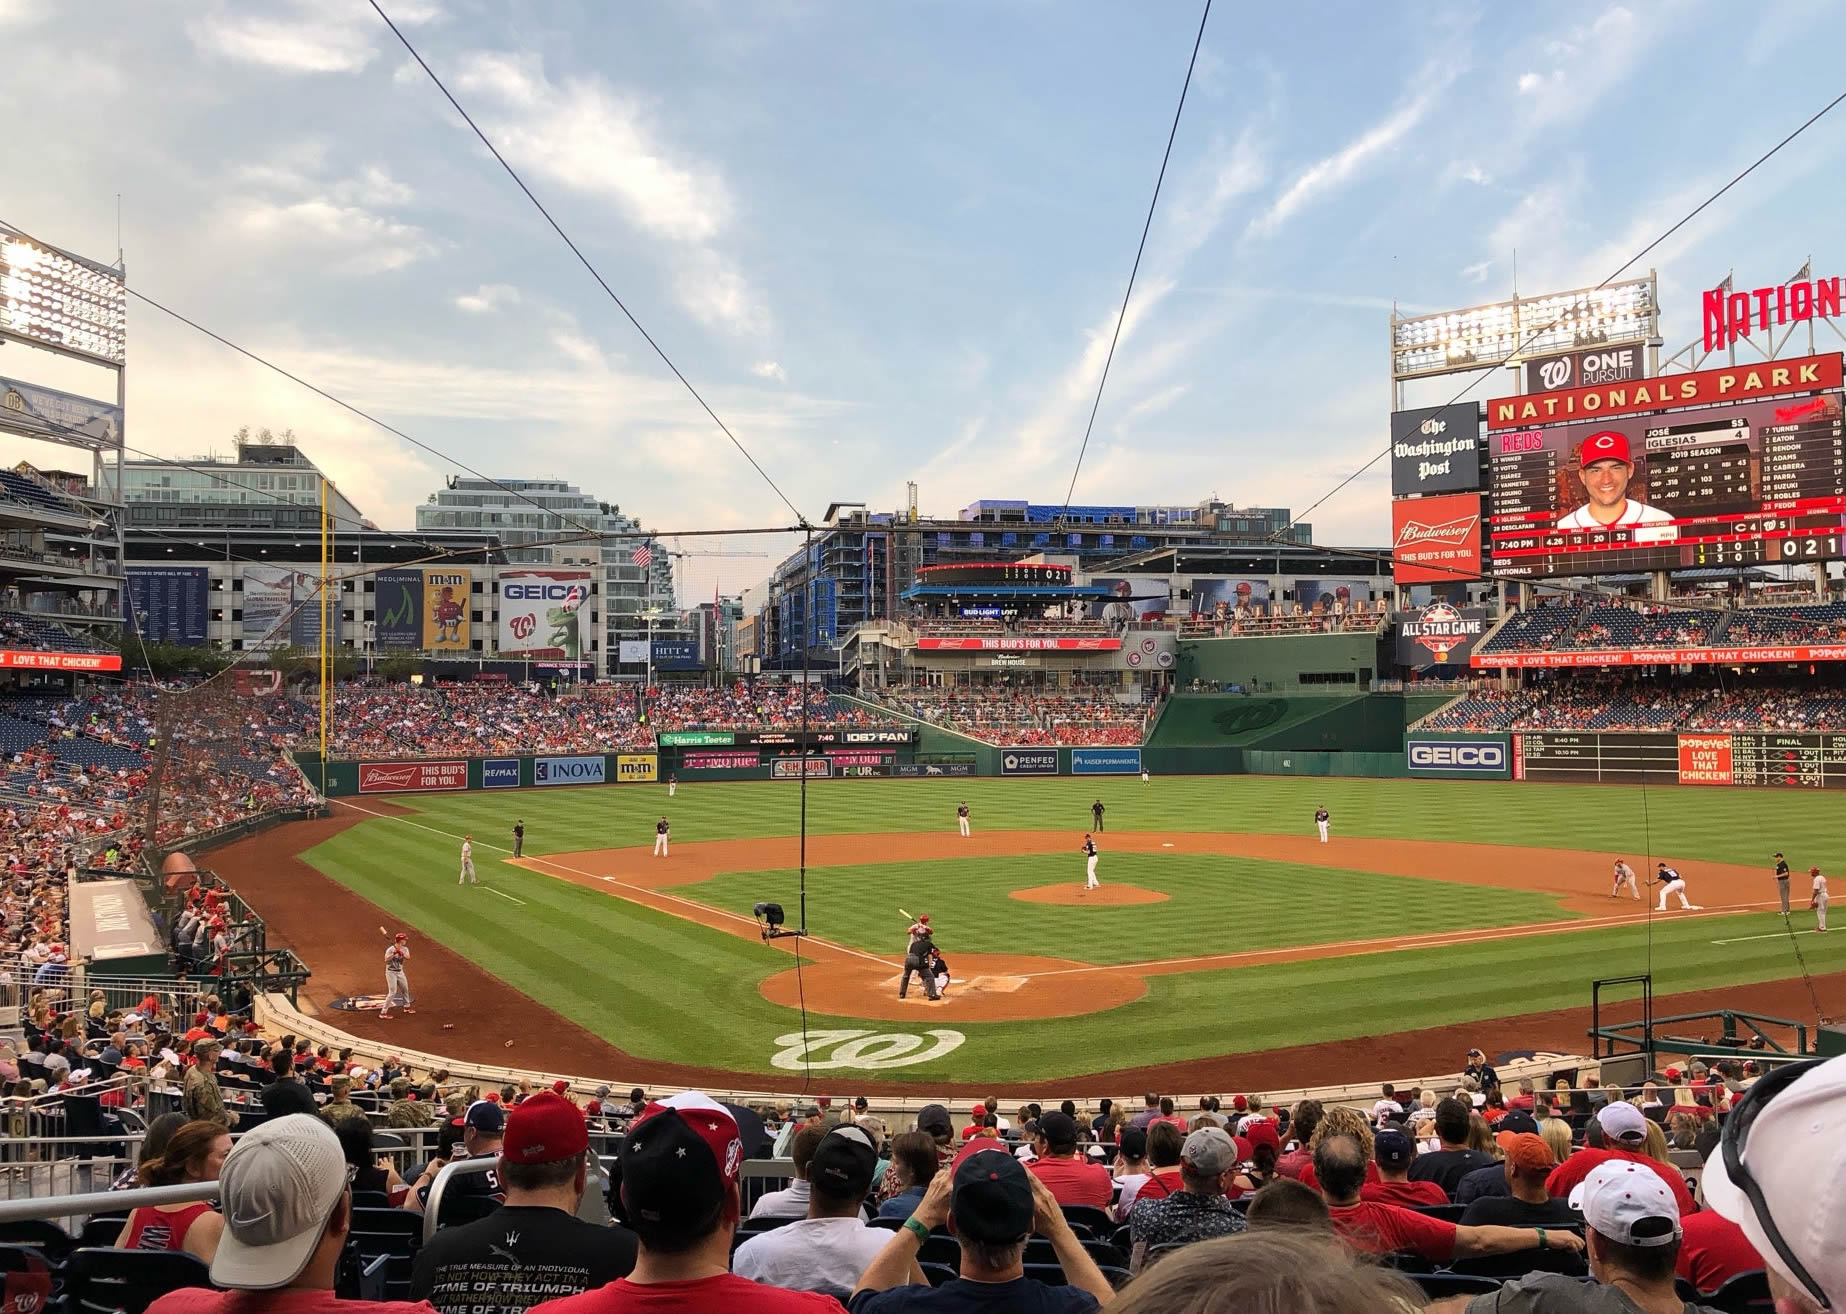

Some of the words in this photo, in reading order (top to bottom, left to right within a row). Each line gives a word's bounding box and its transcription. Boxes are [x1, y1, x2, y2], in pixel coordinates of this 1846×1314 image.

[1703, 277, 1846, 353] NATION
[1583, 350, 1633, 372] ONE
[1583, 366, 1633, 385] PURSUIT
[1499, 380, 1697, 421] NATIONALS
[1719, 364, 1819, 394] PARK
[1421, 419, 1447, 436] The
[1647, 427, 1670, 437] JOSÉ
[1731, 419, 1743, 427] SS
[1772, 425, 1799, 433] TURNER
[1501, 430, 1543, 453] REDS
[1648, 436, 1697, 447] IGLESIAS
[1773, 435, 1794, 443] EATON
[1394, 437, 1476, 458] Washington
[1773, 444, 1801, 452] RENDON
[1671, 451, 1688, 459] 2019
[1690, 448, 1721, 457] SEASON
[1773, 454, 1797, 462] ADAMS
[1419, 459, 1450, 481] Post
[1773, 463, 1805, 471] CABRERA
[1774, 482, 1798, 490] SUZUKI
[1774, 491, 1800, 500] ROBLES
[1501, 506, 1531, 514] BARNHART
[1501, 523, 1535, 531] DESCLAFANI
[1400, 525, 1469, 542] Budweiser
[1500, 541, 1519, 549] 7:40
[1521, 540, 1533, 548] PM
[1573, 536, 1582, 544] 12
[1779, 521, 1785, 529] 5
[1717, 543, 1723, 551] 3
[1735, 542, 1742, 550] 0
[1754, 541, 1759, 549] 1
[1783, 541, 1796, 556] 0
[1806, 539, 1816, 554] 2
[1828, 538, 1835, 553] 1
[1401, 553, 1416, 562] THIS
[1418, 552, 1438, 561] BUD'S
[1441, 551, 1455, 559] FOR
[1457, 549, 1473, 558] YOU.
[1493, 567, 1532, 576] NATIONALS
[1548, 565, 1553, 573] 3
[1699, 555, 1705, 564] 3
[1717, 554, 1723, 562] 3
[1735, 553, 1742, 561] 0
[1754, 551, 1759, 560] 1
[1046, 570, 1052, 578] 0
[1056, 570, 1060, 579] 2
[504, 584, 587, 600] GEICO
[1402, 623, 1421, 637] ALL
[1423, 622, 1449, 636] STAR
[1452, 621, 1480, 634] GAME
[982, 640, 1000, 648] THIS
[1000, 639, 1024, 648] BUD'S
[1026, 639, 1039, 648] FOR
[1042, 639, 1059, 648] YOU.
[13, 655, 36, 665] LOVE
[38, 655, 60, 666] THAT
[62, 657, 101, 667] CHICKEN!
[1523, 656, 1546, 665] LOVE
[1550, 655, 1573, 664] THAT
[1576, 654, 1622, 663] CHICKEN!
[1680, 652, 1707, 661] LOVE
[1711, 651, 1738, 660] THAT
[1742, 650, 1795, 659] CHICKEN!
[674, 736, 702, 744] Harris
[704, 736, 731, 744] Teeter
[879, 732, 908, 741] FAN
[1776, 738, 1801, 746] FINAL
[1411, 746, 1501, 765] GEICO
[1692, 751, 1717, 760] LOVE
[552, 763, 603, 778] INOVA
[1692, 761, 1718, 770] THAT
[368, 772, 411, 783] Budweiser
[421, 766, 439, 775] THIS
[441, 765, 465, 775] BUD'S
[485, 768, 517, 777] RE/MAX
[1681, 771, 1729, 781] CHICKEN!
[421, 777, 436, 786] FOR
[439, 776, 457, 785] YOU.
[14, 1120, 22, 1135] C
[436, 1265, 447, 1273] THE
[470, 1263, 509, 1271] MEASURE
[537, 1265, 590, 1275] INDIVIDUAL
[447, 1272, 467, 1282] NOT
[470, 1271, 498, 1281] HOW
[534, 1273, 559, 1282] ACT
[563, 1274, 577, 1284] IN
[581, 1275, 588, 1285] A
[433, 1282, 469, 1294] TIME
[473, 1282, 496, 1291] OF
[500, 1282, 585, 1295] TRIUMPH
[450, 1293, 486, 1304] RATHER
[472, 1305, 494, 1314] OF
